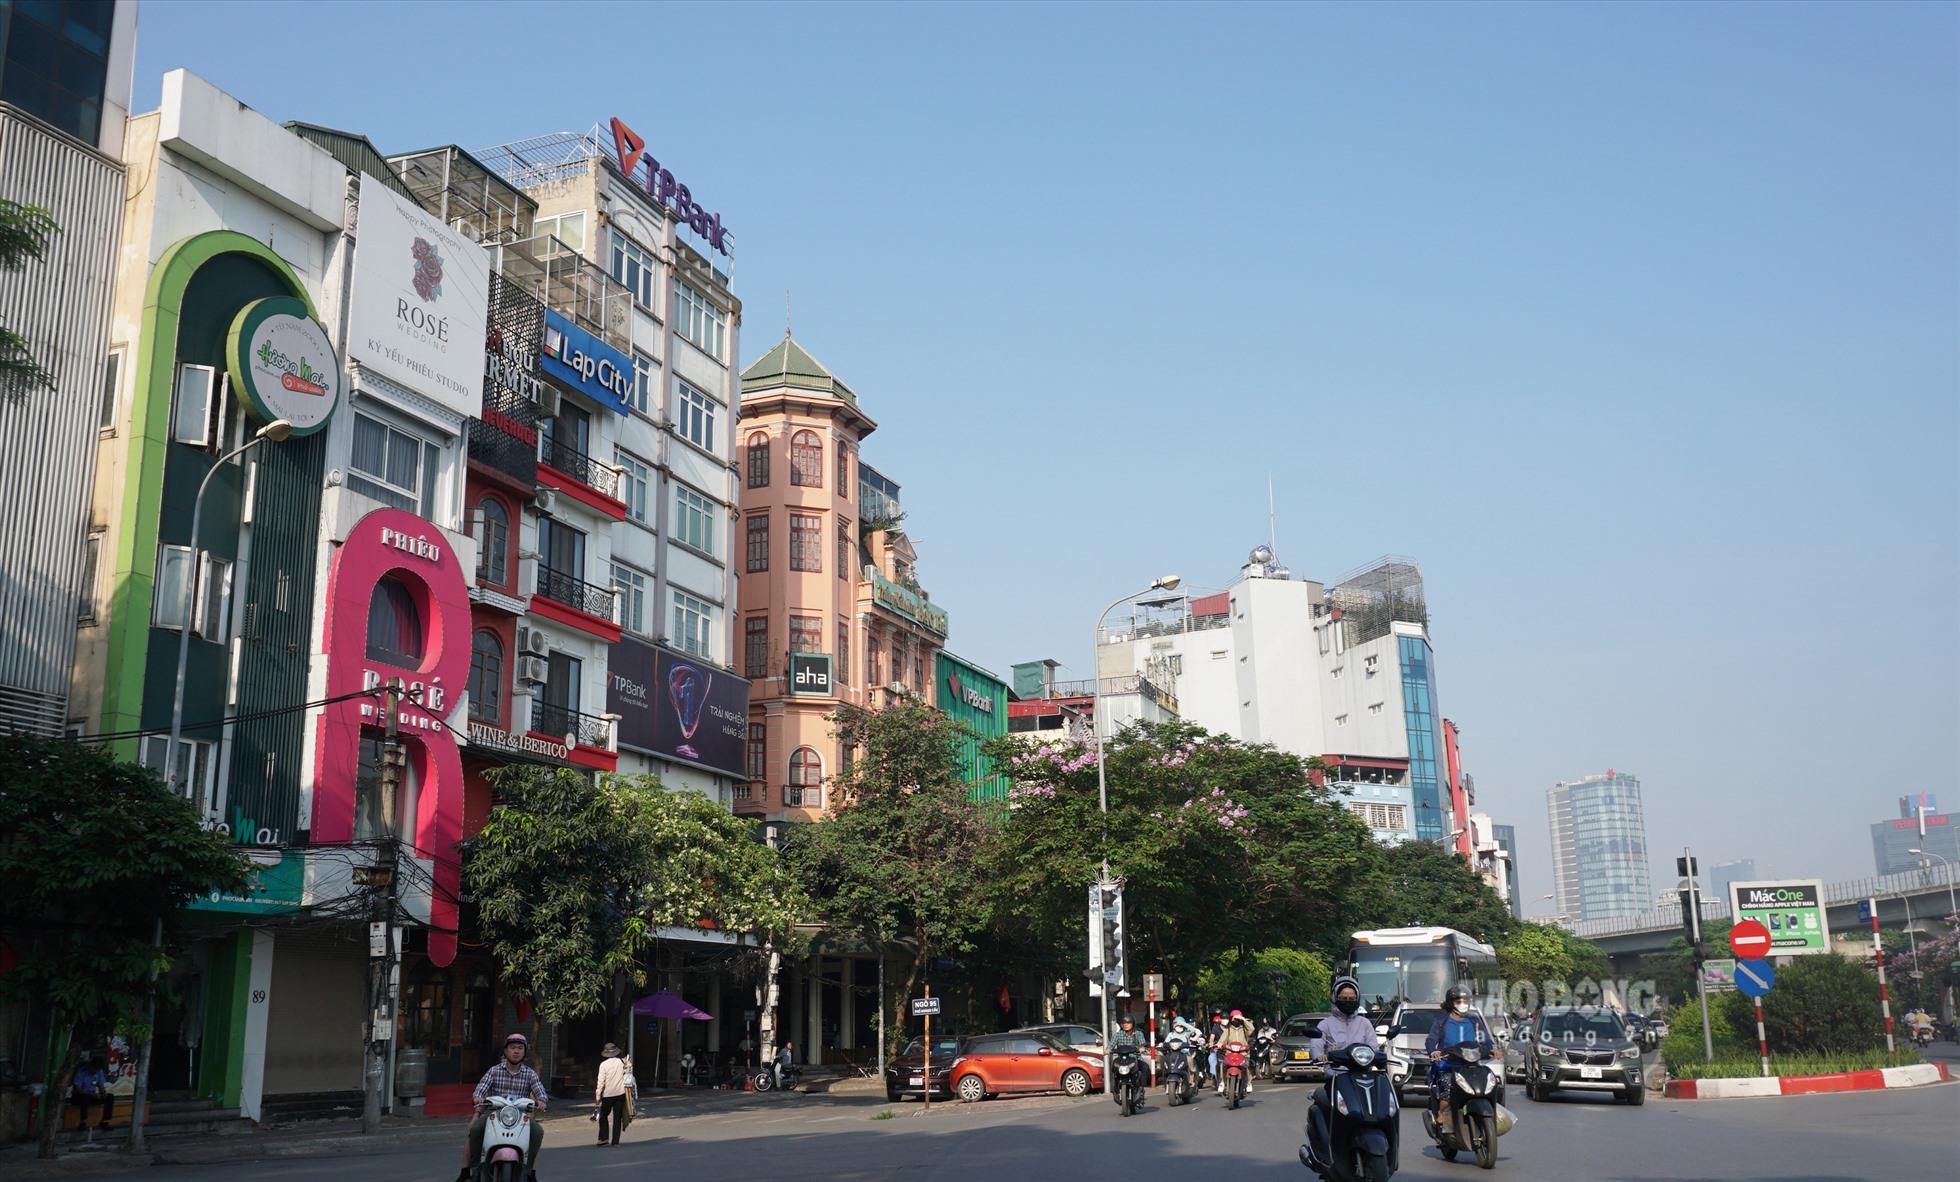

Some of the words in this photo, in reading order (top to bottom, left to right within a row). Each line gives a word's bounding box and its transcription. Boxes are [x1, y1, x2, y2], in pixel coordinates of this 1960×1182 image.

[643, 152, 728, 257] TPBank
[396, 298, 450, 344] ROSÉ
[397, 323, 448, 354] WEDDING
[435, 374, 469, 397] STUDIO
[562, 335, 595, 383] Lap
[597, 358, 633, 406] City
[381, 526, 441, 563] PHIÊU
[614, 675, 647, 700] TPBank
[796, 665, 827, 685] aha
[962, 685, 993, 714] VPBank
[360, 703, 442, 733] WEDING
[470, 723, 506, 746] WINE
[507, 732, 519, 748] &
[519, 735, 567, 760] IBERICO
[252, 989, 266, 1004] 89
